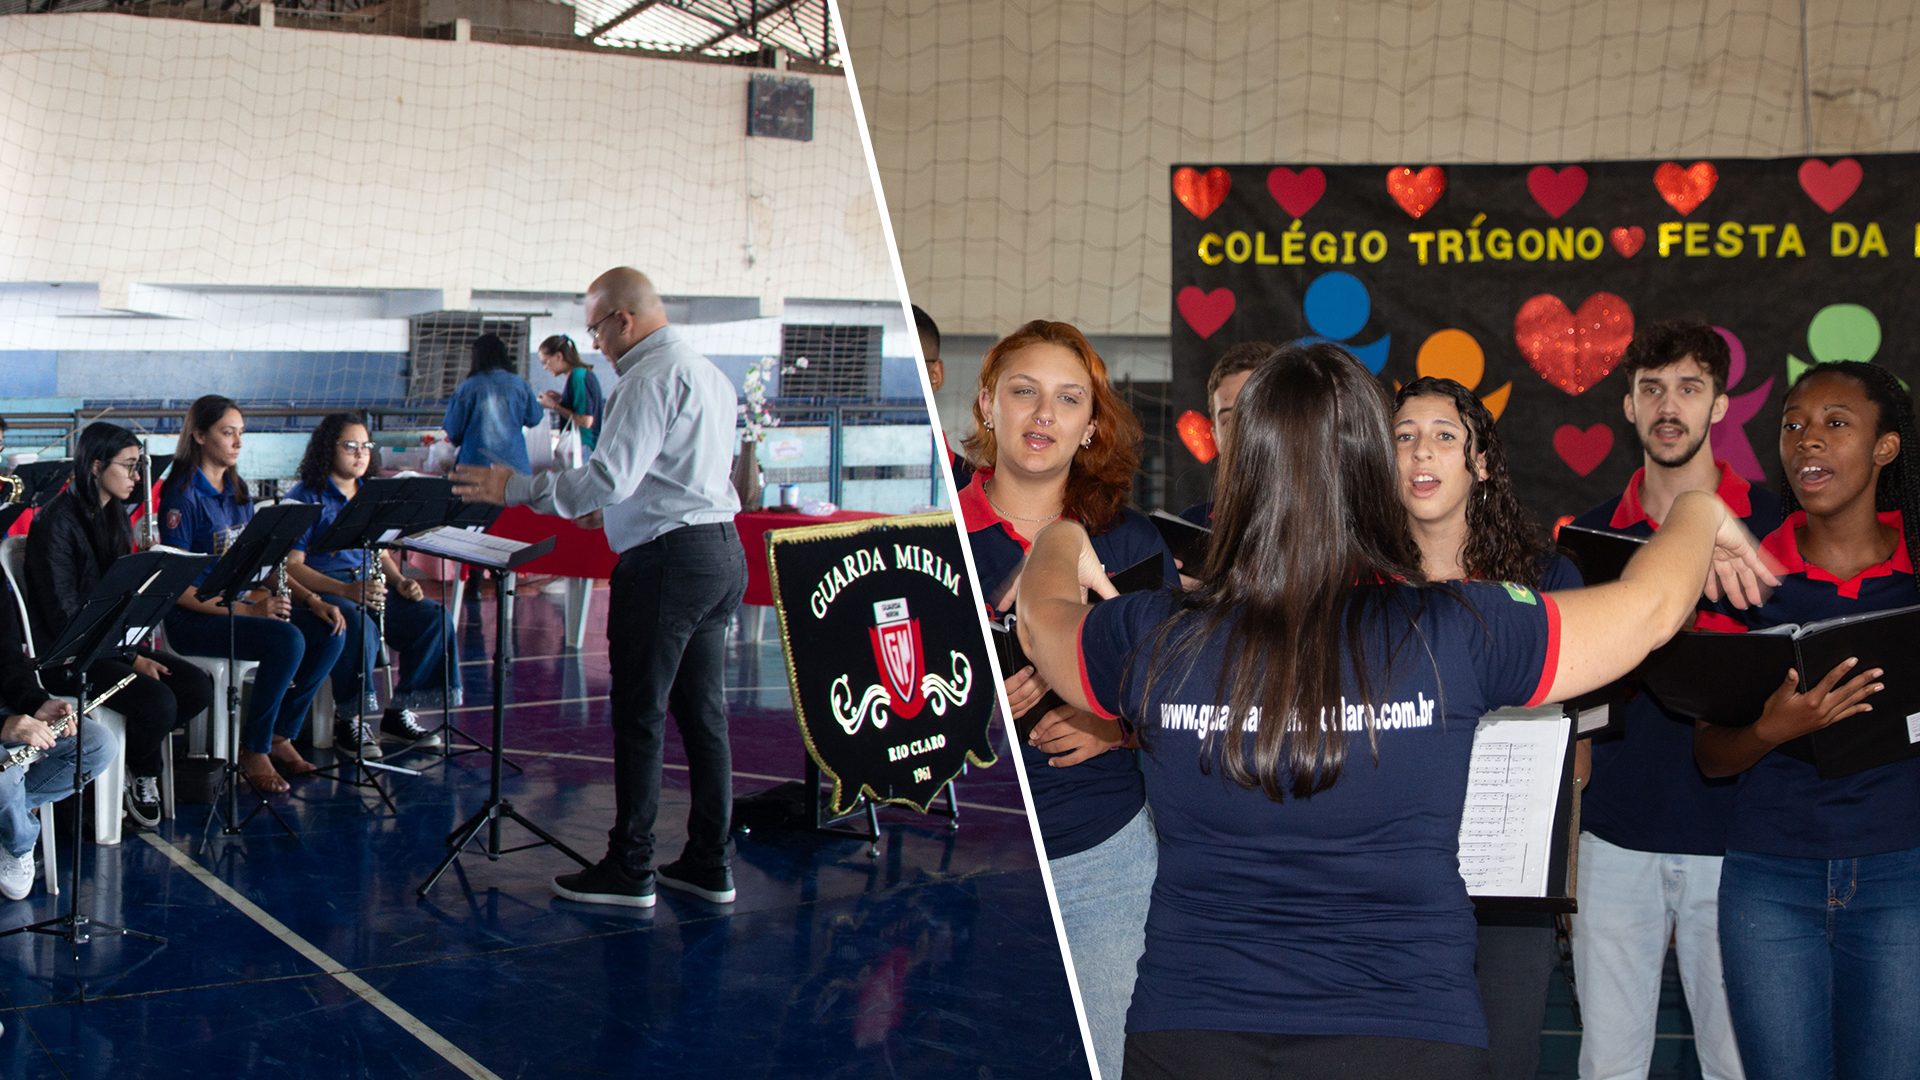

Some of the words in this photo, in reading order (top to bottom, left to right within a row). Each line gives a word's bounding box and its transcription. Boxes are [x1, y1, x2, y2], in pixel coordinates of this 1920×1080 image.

[1198, 218, 1388, 266] COLÉGIO
[1408, 212, 1604, 266] TRÍGONO
[1657, 221, 1806, 258] FESTA
[1830, 222, 1889, 258] DA
[810, 546, 887, 620] GUARDA
[893, 543, 961, 597] MIRIM
[887, 744, 910, 763] RIO
[910, 733, 946, 757] CLARO
[912, 765, 932, 784] 1961
